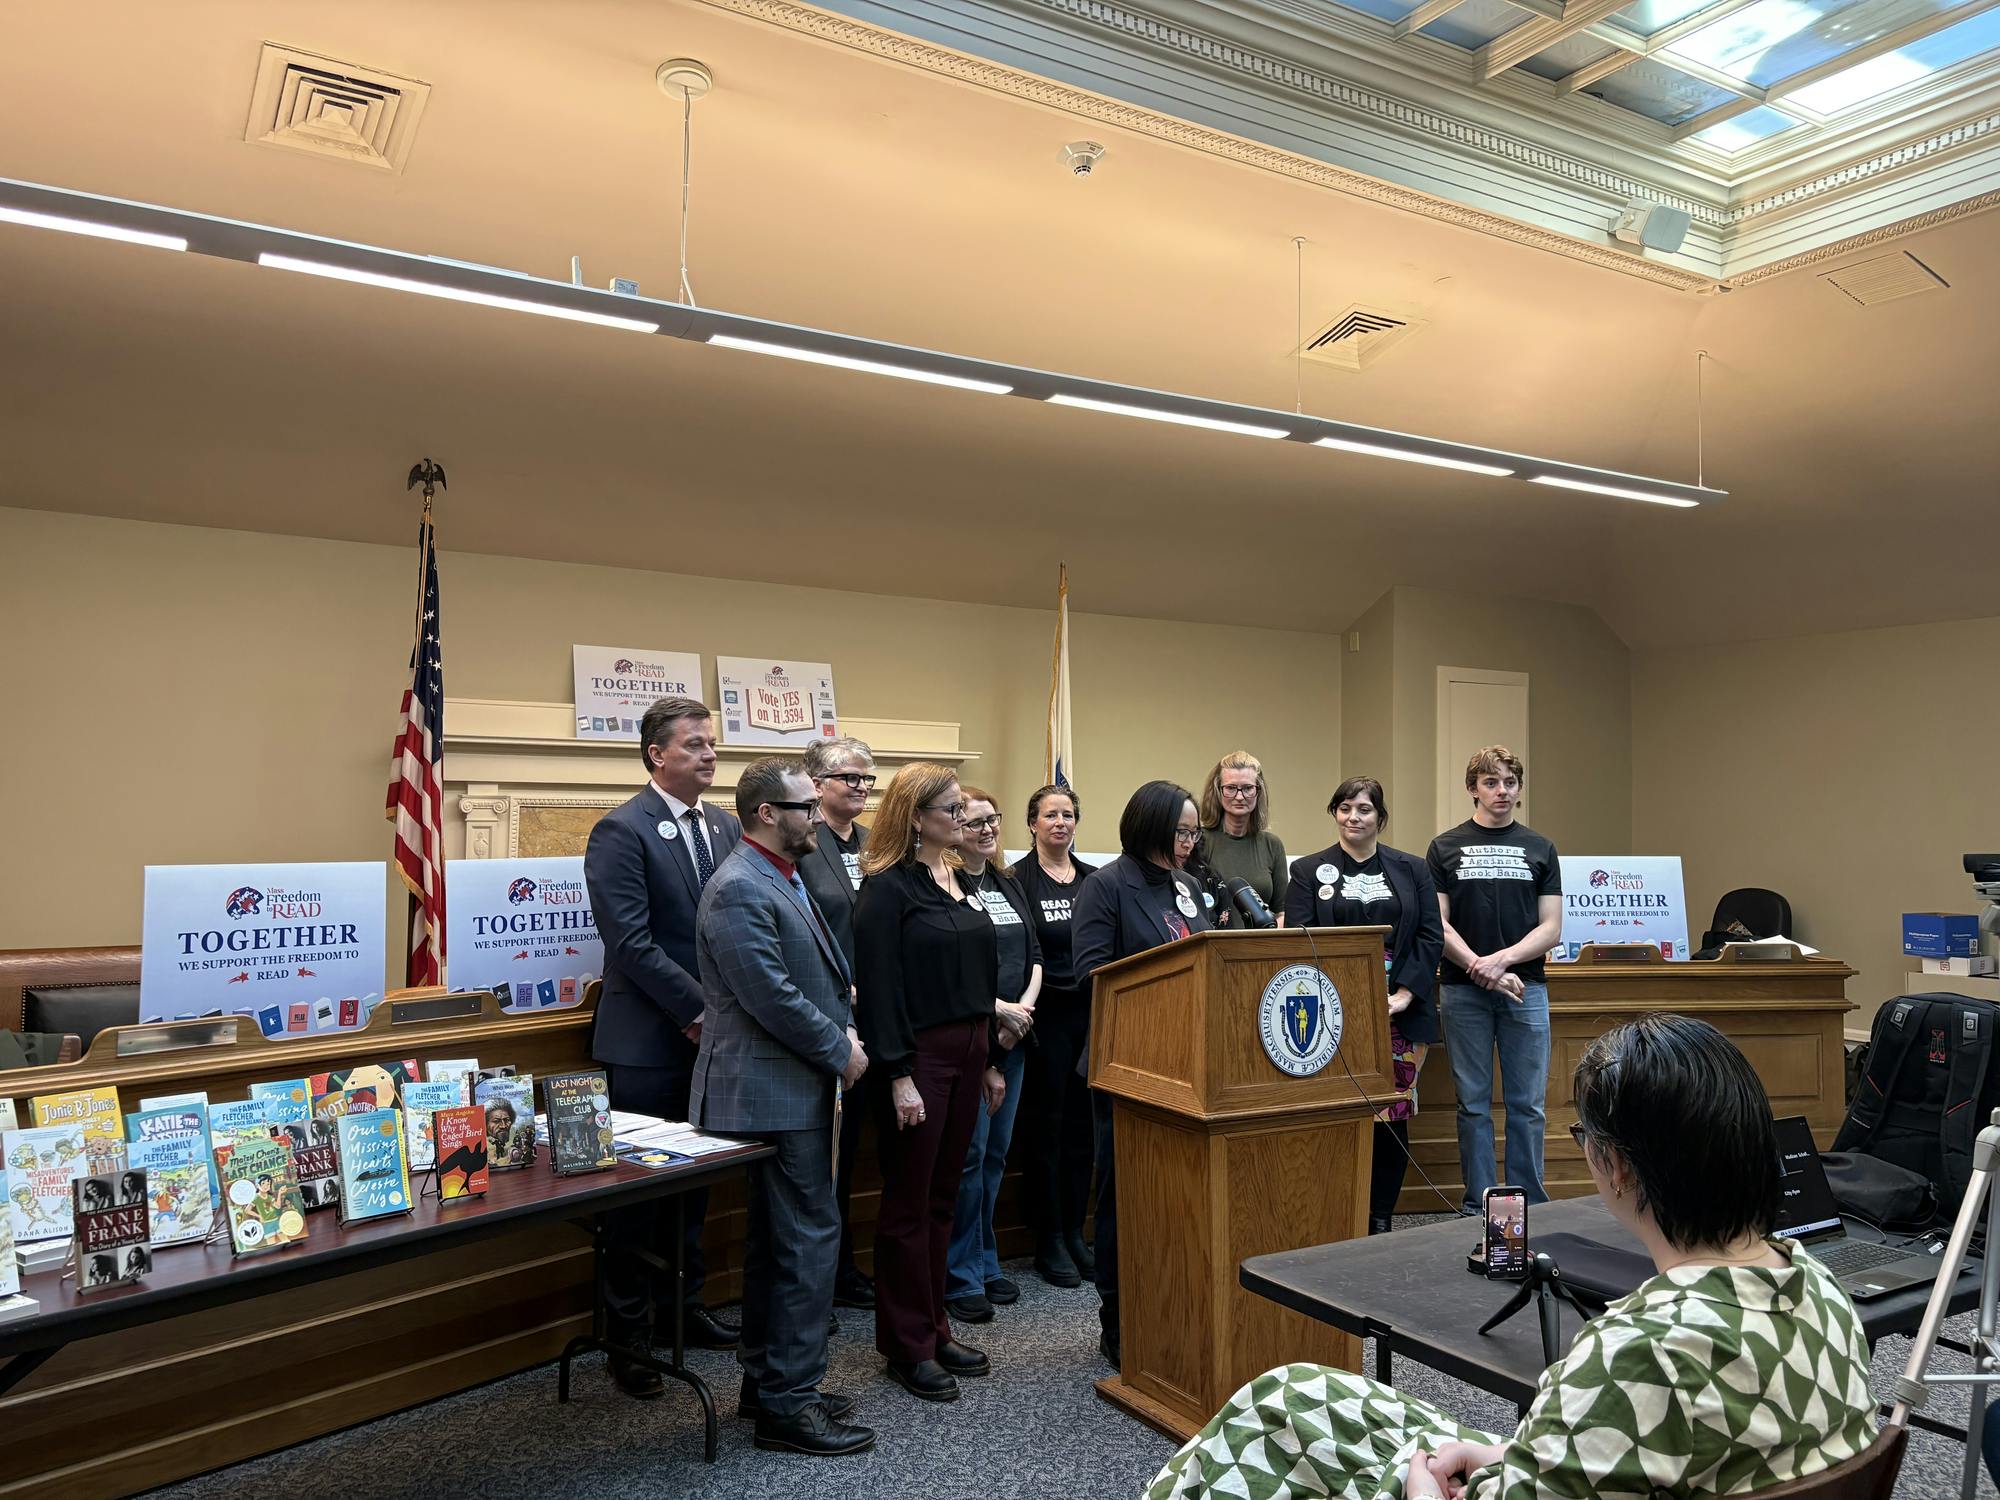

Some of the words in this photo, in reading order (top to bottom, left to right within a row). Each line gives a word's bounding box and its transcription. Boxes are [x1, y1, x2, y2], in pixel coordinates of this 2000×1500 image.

[638, 670, 665, 678] READ
[592, 678, 687, 694] TOGETHER
[758, 688, 779, 708] Vote
[782, 691, 800, 707] YES
[758, 709, 769, 722] on
[1497, 869, 1526, 878] Bans
[1611, 873, 1642, 882] Freedom
[539, 880, 582, 894] Freedom
[1615, 880, 1643, 889] READ
[267, 890, 321, 905] Freedom
[544, 891, 582, 905] READ
[1566, 894, 1668, 907] TOGETHER
[272, 902, 321, 919] READ
[1041, 900, 1070, 910] READ
[473, 910, 596, 935] TOGETHE
[178, 924, 359, 954] TOGETHER
[492, 938, 535, 948] SUPPORT
[558, 933, 600, 943] FREEDOM
[178, 961, 199, 971] WE
[202, 957, 258, 970] SUPPORT
[261, 955, 285, 965] THE
[288, 951, 342, 963] FREEDOM
[345, 950, 359, 959] TO
[534, 949, 559, 958] READ
[257, 970, 289, 980] READ
[551, 1080, 568, 1089] LAST
[570, 1077, 592, 1087] NIGHT
[238, 1102, 265, 1112] FAMILY
[556, 1095, 595, 1106] TELEGRAPH
[42, 1104, 72, 1125] Junie
[85, 1098, 116, 1117] Jones
[222, 1112, 253, 1121] FLETCHER
[278, 1105, 307, 1119] ssing
[574, 1105, 592, 1114] CLUB
[139, 1114, 184, 1136] KATIE
[184, 1118, 199, 1126] THE
[441, 1125, 456, 1133] Why
[347, 1125, 378, 1141] Our
[441, 1132, 463, 1140] Caged
[466, 1129, 482, 1137] Bird
[162, 1140, 191, 1152] FAMILY
[347, 1139, 397, 1157] Missing
[144, 1152, 178, 1162] FLETCHER
[250, 1155, 287, 1169] CHANCE
[351, 1154, 392, 1173] Hearts
[27, 1167, 75, 1177] MISADVENTURES
[297, 1160, 332, 1174] RANK
[39, 1174, 68, 1186] FAMILY
[32, 1186, 73, 1198] FLETCHER
[351, 1178, 399, 1197] Celeste
[367, 1192, 386, 1207] Ng
[88, 1209, 143, 1230] ANNE
[88, 1222, 144, 1243] FRANK
